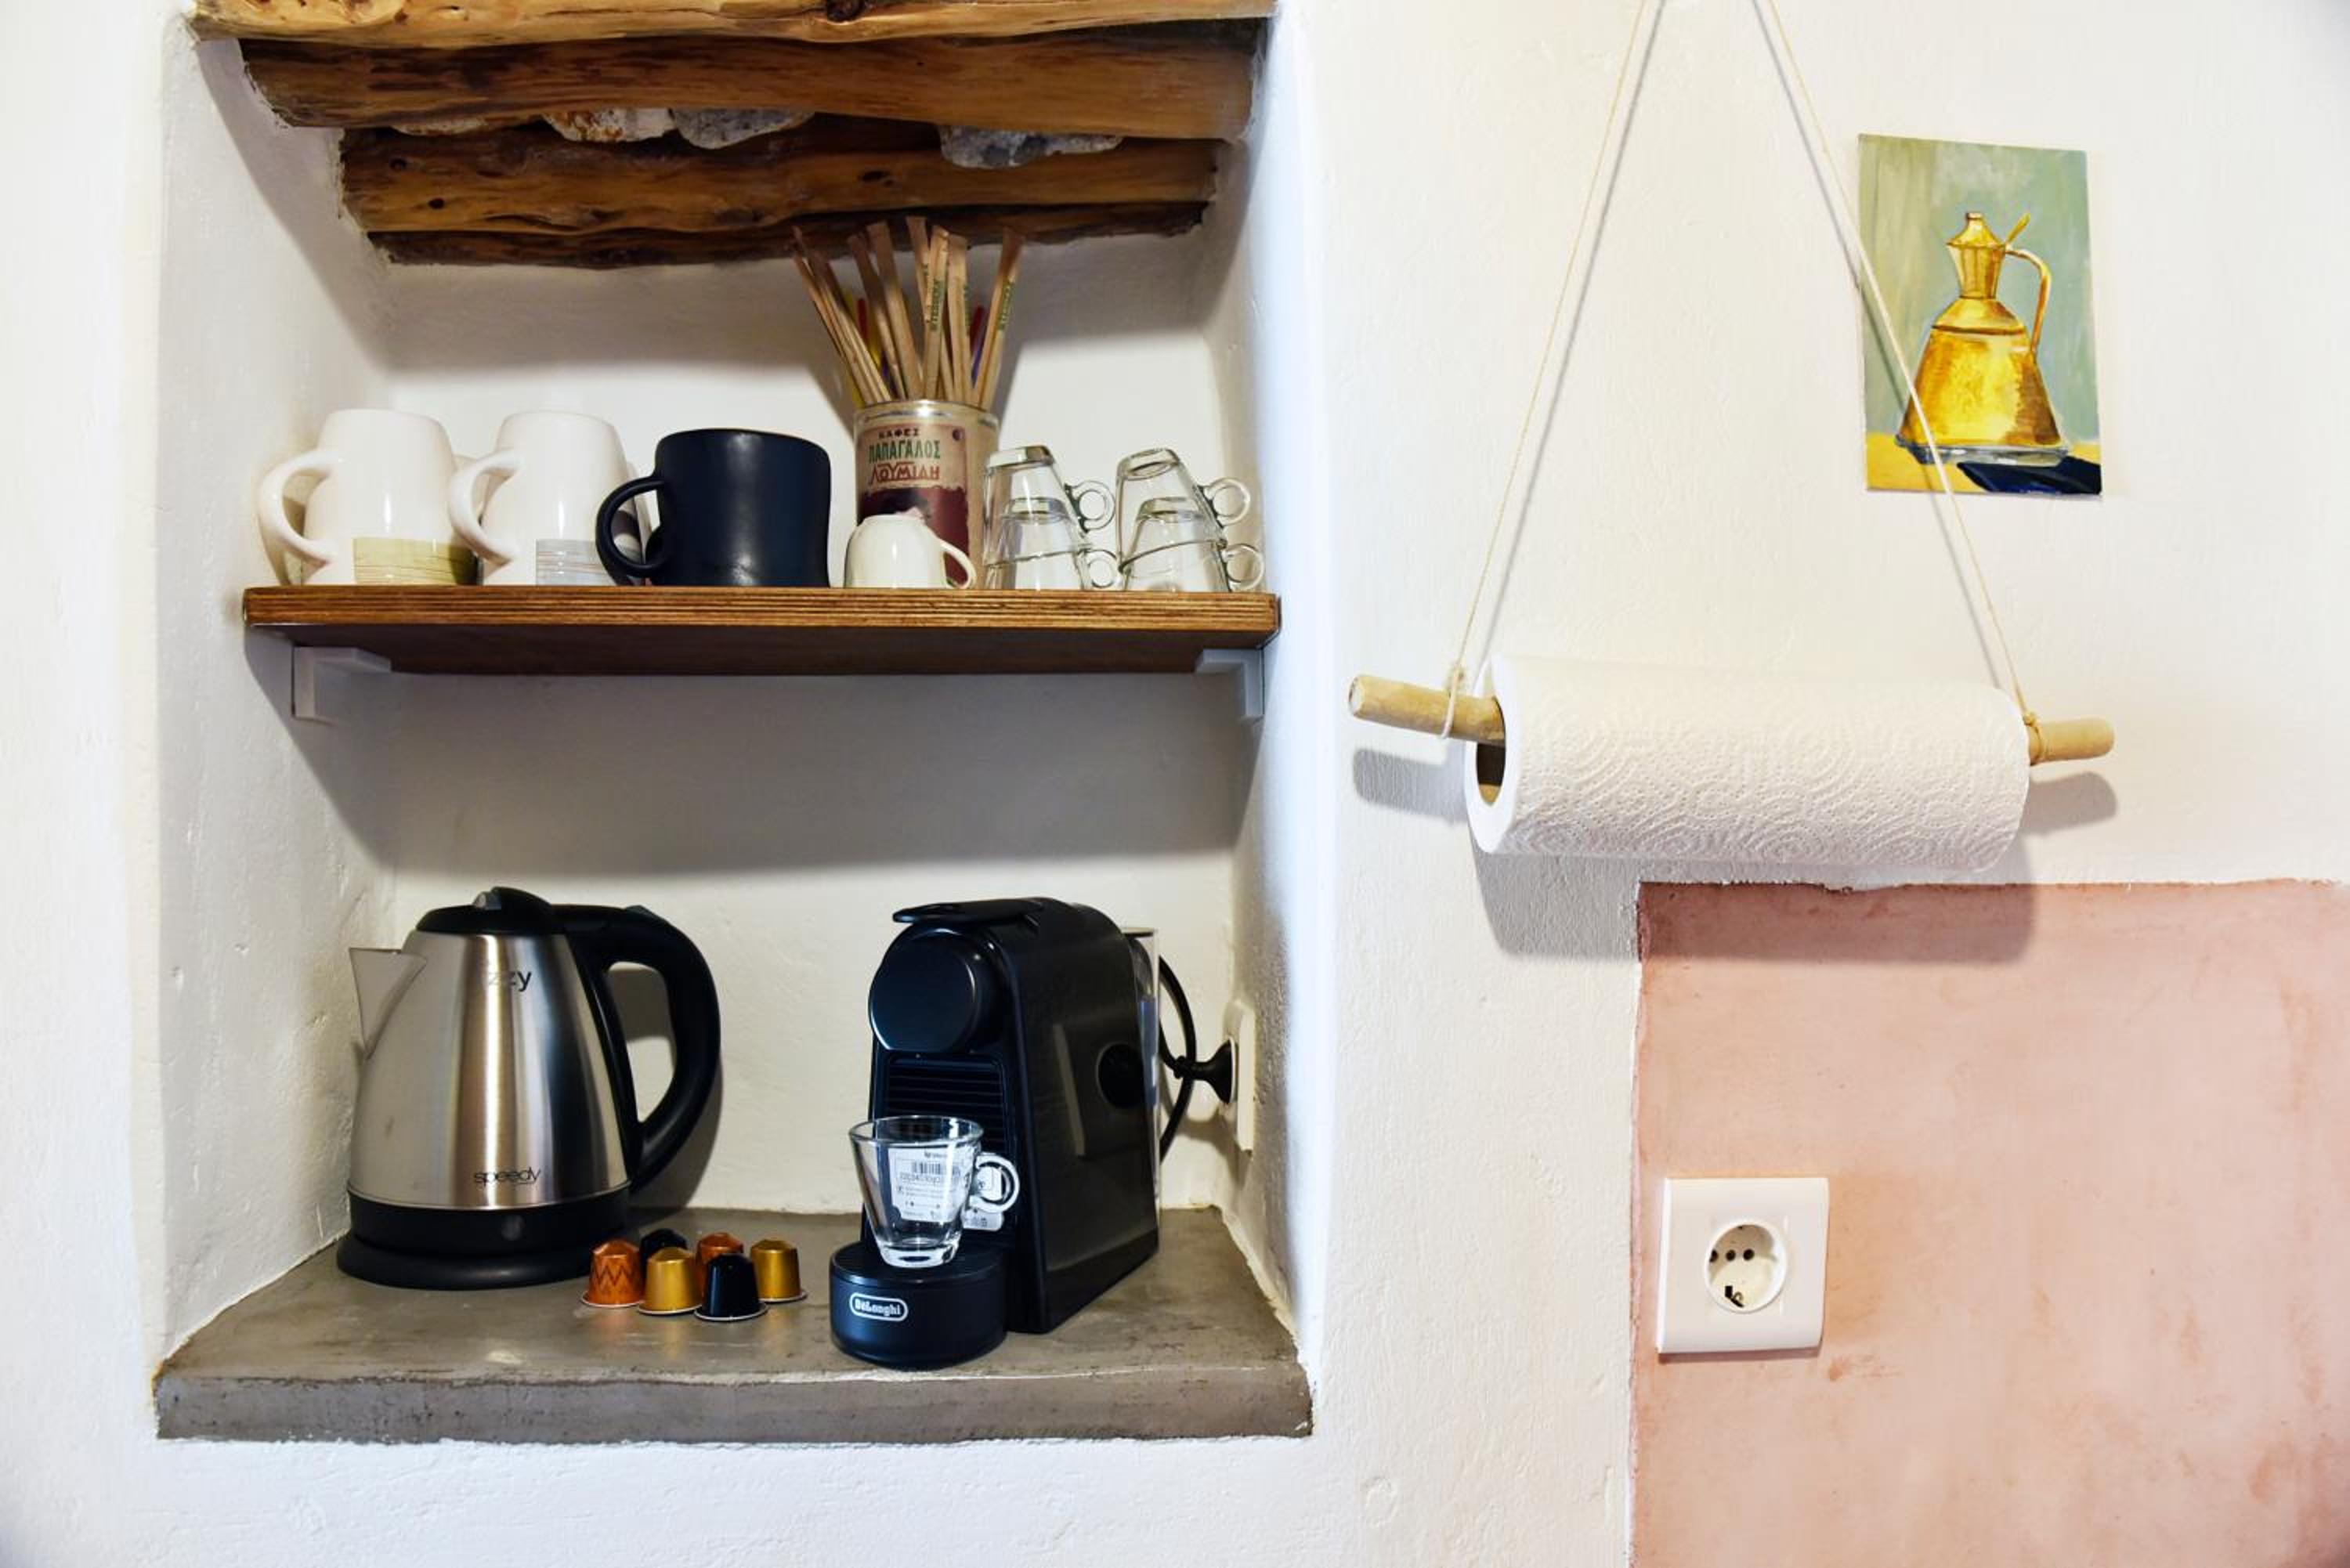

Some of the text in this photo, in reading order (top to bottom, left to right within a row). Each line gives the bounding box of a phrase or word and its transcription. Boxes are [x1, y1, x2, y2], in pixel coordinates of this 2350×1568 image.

[878, 428, 920, 439] ΚΑΦΕΣ
[869, 439, 941, 464] ΠΑΠΑΓΑΛΟΣ
[868, 461, 940, 485] ΛΟΥΜΙΔΗ
[474, 1166, 542, 1187] speedy
[855, 1298, 902, 1317] DeLonghi
